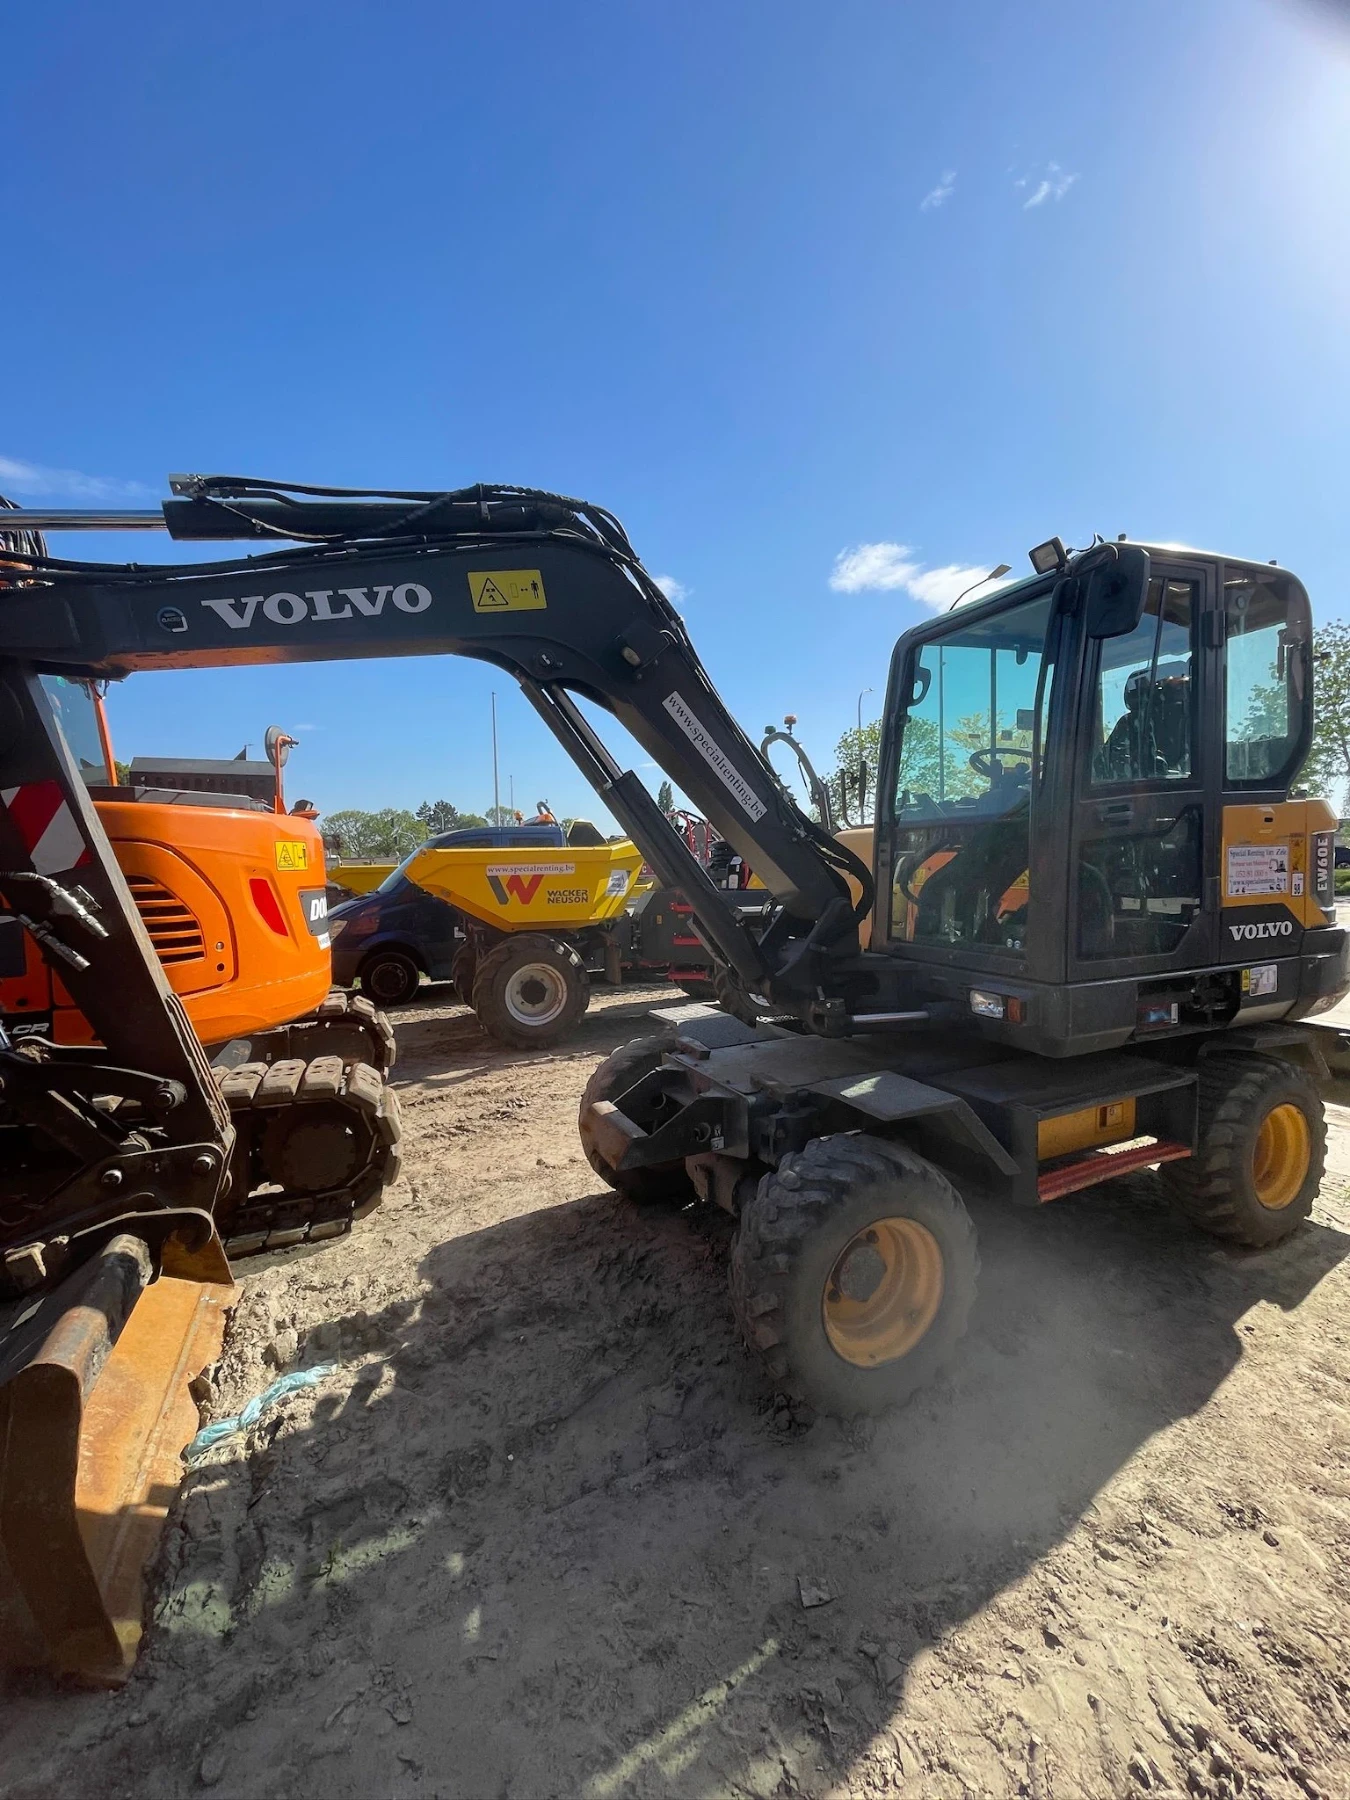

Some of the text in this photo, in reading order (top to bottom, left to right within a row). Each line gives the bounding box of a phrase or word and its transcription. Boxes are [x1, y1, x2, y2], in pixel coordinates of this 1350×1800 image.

[201, 583, 432, 629] VOLVO
[668, 696, 763, 817] www.specialrenting.be
[487, 865, 575, 875] www.specialrenting.be
[1317, 838, 1328, 891] EW60E
[1228, 921, 1293, 940] VOLVO
